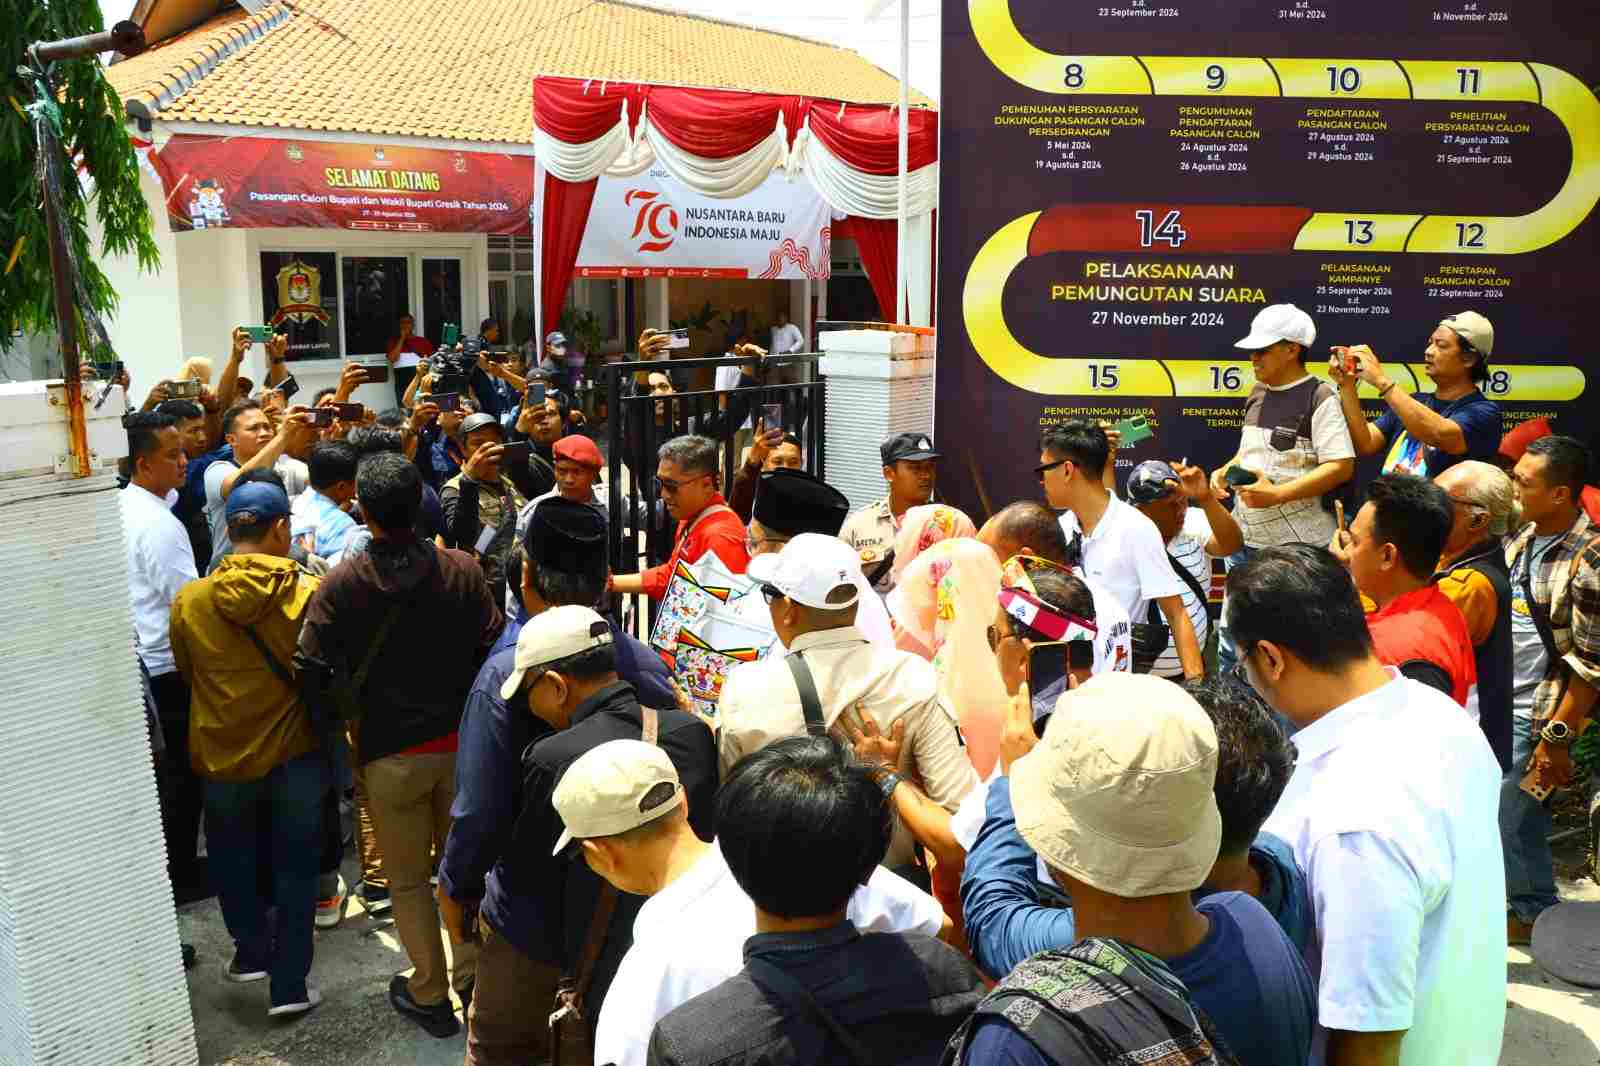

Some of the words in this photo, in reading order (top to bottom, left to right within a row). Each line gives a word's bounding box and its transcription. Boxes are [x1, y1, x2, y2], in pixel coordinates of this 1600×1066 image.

[1111, 8, 1156, 18] September
[1159, 8, 1179, 17] 2024
[1306, 10, 1326, 18] 2024
[1443, 12, 1486, 21] November
[1488, 13, 1508, 21] 2024
[1064, 63, 1084, 88] 8
[1205, 65, 1226, 90] 9
[1326, 67, 1361, 92] 10
[1456, 68, 1481, 94] 11
[1001, 105, 1065, 114] PEMENUHAN
[1068, 106, 1138, 115] PERSYARATAN
[1179, 107, 1253, 116] PENGUMUMAN
[1307, 109, 1380, 119] PENDAFTARAN
[994, 116, 1052, 125] DUKUNGAN
[1054, 117, 1109, 126] PASANGAN
[1111, 117, 1145, 126] CALON
[1450, 112, 1507, 121] PENELITIAN
[1179, 118, 1252, 127] PENDAFTARAN
[1298, 120, 1352, 129] PASANGAN
[1354, 121, 1388, 130] CALON
[1028, 128, 1110, 137] PERSEORANGAN
[1425, 123, 1494, 132] PERSYARATAN
[1496, 124, 1530, 133] CALON
[1170, 129, 1224, 138] PASANGAN
[1226, 130, 1260, 139] CALON
[1308, 133, 1318, 141] 27
[1320, 133, 1353, 144] Agustus
[1355, 134, 1375, 142] 2024
[1071, 141, 1091, 149] 2024
[1455, 135, 1488, 146] Agustus
[1489, 136, 1509, 145] 2024
[1180, 143, 1190, 151] 24
[1192, 143, 1226, 153] Agustus
[1228, 143, 1248, 152] 2024
[1319, 152, 1352, 163] Agustus
[1354, 153, 1374, 161] 2024
[1447, 155, 1491, 166] September
[1492, 156, 1512, 164] 2024
[1035, 160, 1044, 169] 19
[1046, 161, 1079, 171] Agustus
[1082, 161, 1102, 169] 2024
[1192, 162, 1225, 172] Agustus
[1227, 163, 1247, 171] 2024
[326, 168, 387, 189] SELAMAT
[391, 170, 440, 192] DATANG
[250, 192, 300, 203] Pasangan
[301, 193, 328, 203] Calon
[361, 195, 379, 205] dan
[406, 198, 434, 209] Bupati
[435, 199, 461, 208] Gresik
[463, 201, 487, 210] Tahun
[488, 202, 509, 210] 2024
[686, 208, 754, 223] NUSANTARA
[757, 212, 785, 224] BARU
[684, 226, 748, 240] INDONESIA
[750, 228, 781, 241] MAJU
[1136, 210, 1186, 248] 14
[1344, 220, 1375, 245] 13
[1456, 223, 1485, 248] 12
[1086, 263, 1234, 280] PELAKSANAAN
[1321, 264, 1391, 273] PELAKSANAAN
[1440, 266, 1496, 275] PENETAPAN
[1329, 275, 1381, 284] KAMPANYE
[1424, 277, 1475, 286] PASANGAN
[1477, 278, 1511, 287] CALON
[1051, 286, 1193, 302] PEMUNGUTAN
[1199, 287, 1266, 303] SUARA
[1328, 287, 1372, 298] September
[1374, 288, 1392, 296] 2024
[1440, 289, 1482, 299] September
[1484, 290, 1503, 298] 2024
[1328, 305, 1368, 314] November
[1371, 306, 1390, 315] 2024
[1092, 311, 1108, 325] 27
[1113, 312, 1186, 326] November
[1191, 313, 1225, 326] 2024
[1088, 364, 1120, 389] 15
[1210, 366, 1241, 391] 16
[1044, 407, 1120, 417] PENGHITUNGAN
[1122, 408, 1155, 417] SUARA
[1183, 408, 1239, 417] PENETAPAN
